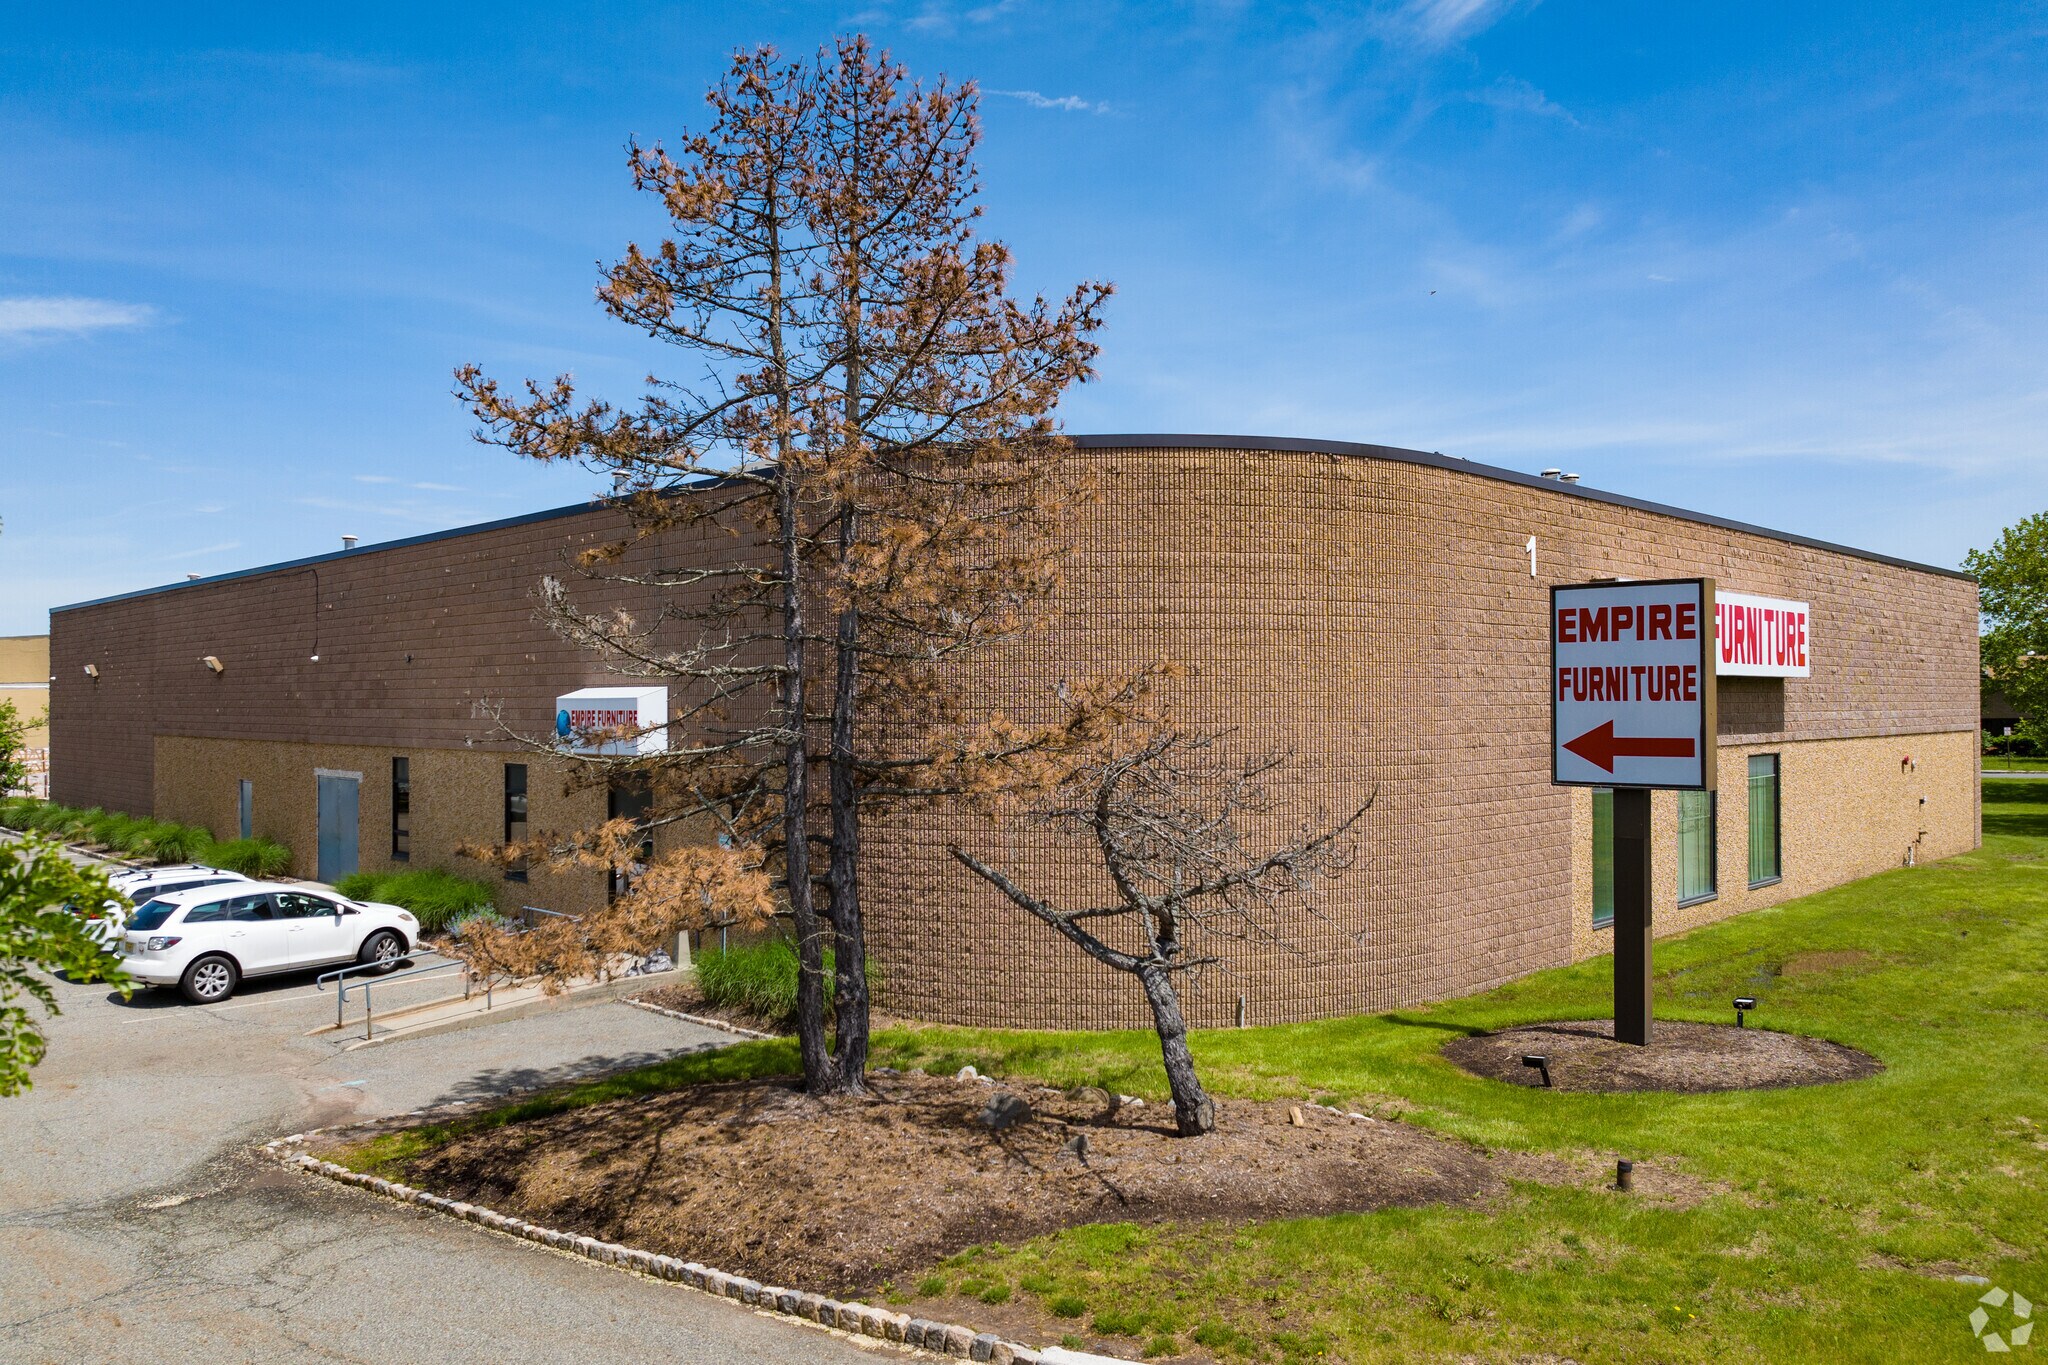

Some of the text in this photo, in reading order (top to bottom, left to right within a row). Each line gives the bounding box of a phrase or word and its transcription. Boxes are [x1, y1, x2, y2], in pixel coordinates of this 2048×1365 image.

[1526, 535, 1537, 577] 1
[1558, 603, 1697, 643] EMPIRE
[1558, 665, 1697, 702] FURNITURE
[571, 710, 638, 728] EMPIRE FURNITURE
